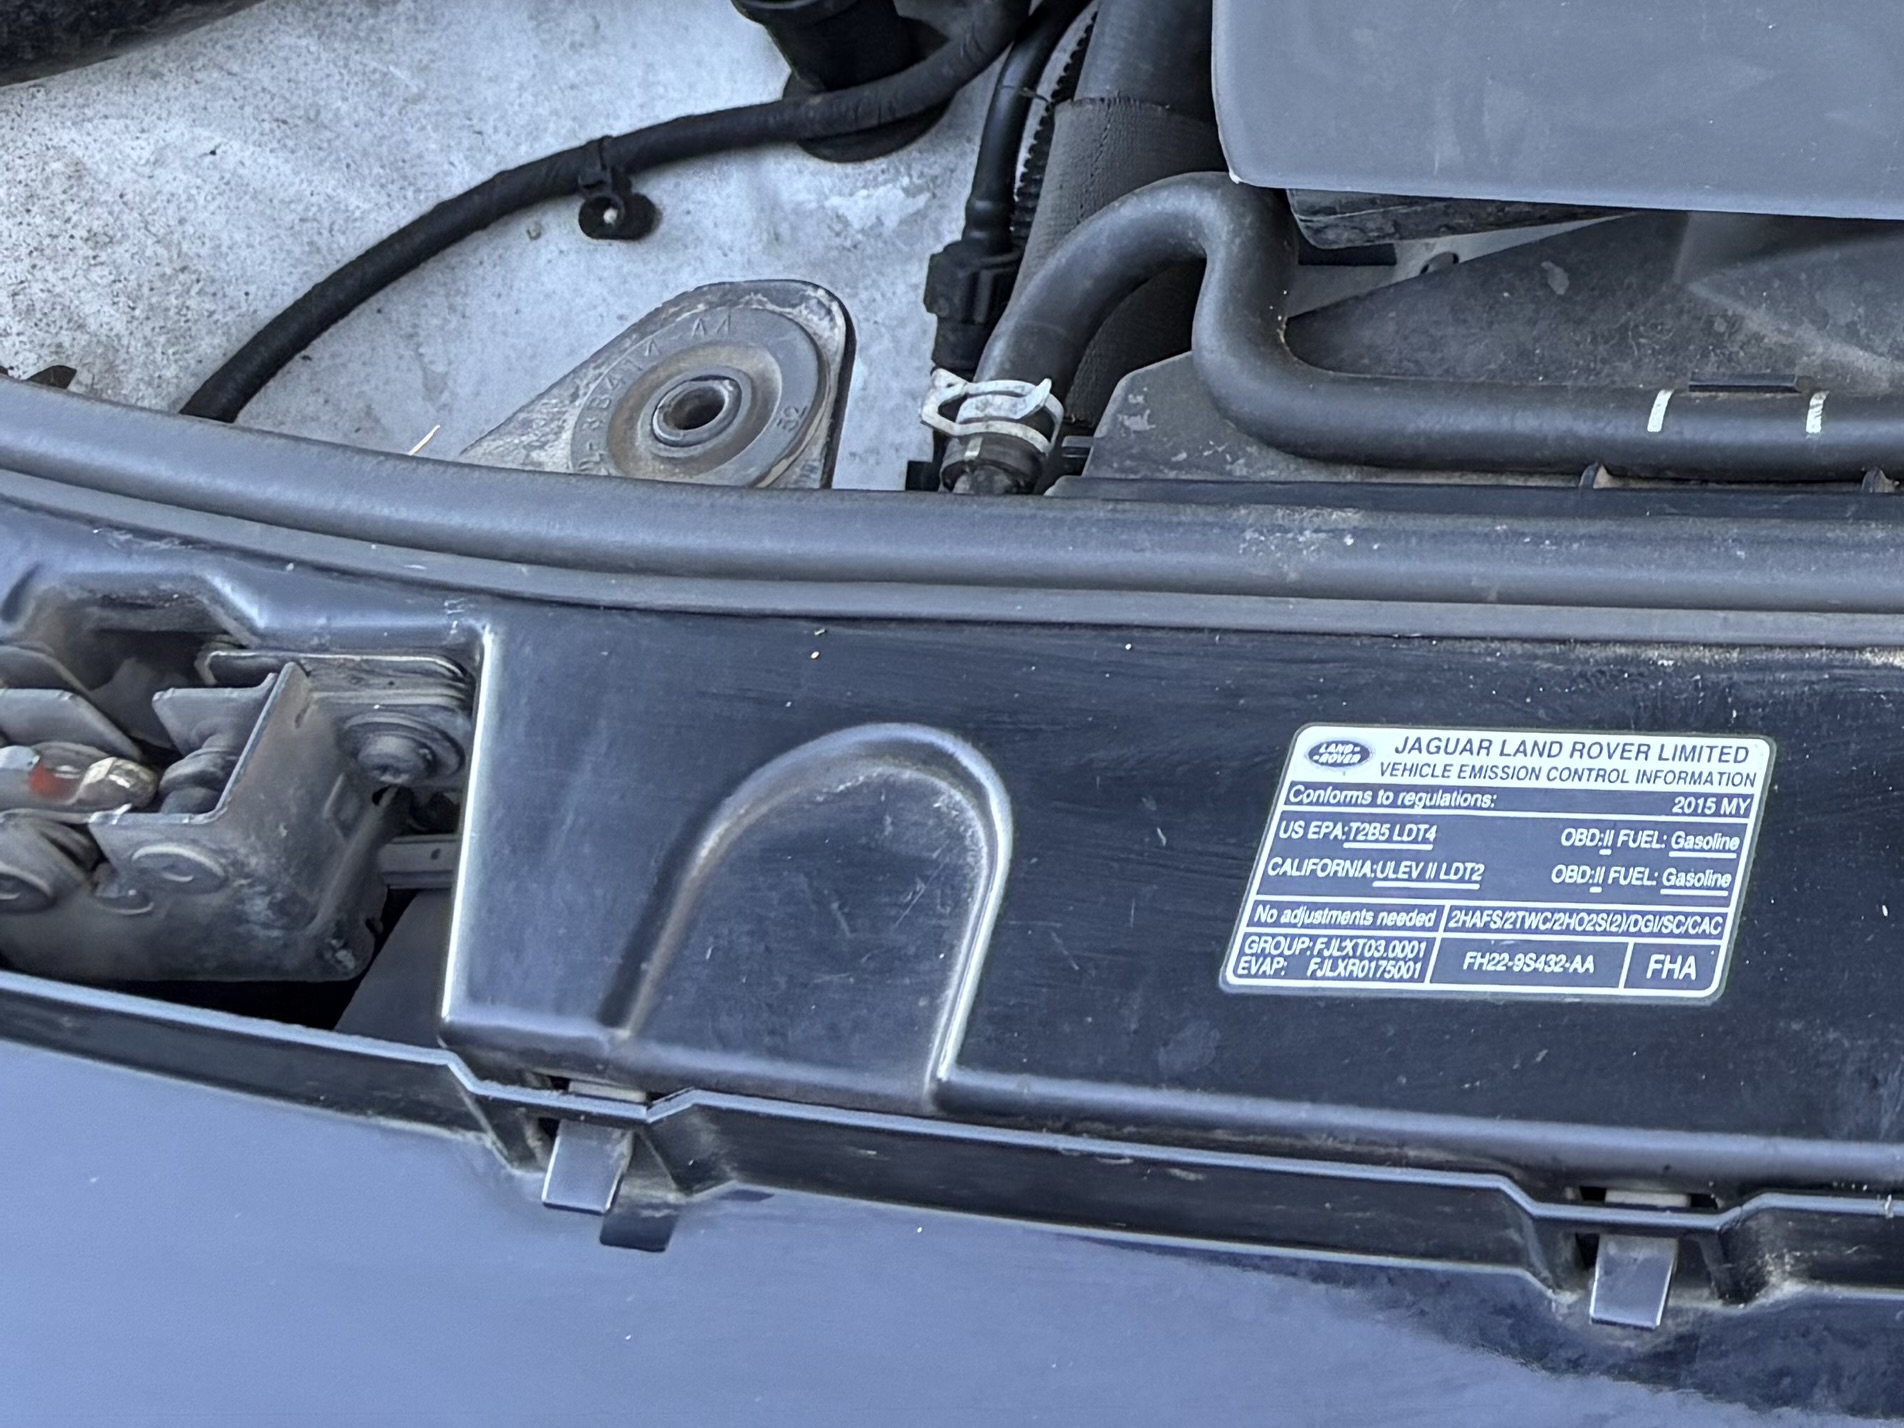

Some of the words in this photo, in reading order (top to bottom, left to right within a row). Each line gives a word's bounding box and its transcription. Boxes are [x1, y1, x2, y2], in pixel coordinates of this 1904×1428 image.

[1394, 736, 1493, 757] JAGUAR
[1499, 739, 1562, 758] LAND
[1569, 741, 1651, 762] ROVER
[1657, 743, 1750, 764] LIMITED
[1379, 761, 1454, 778] VEHICLE
[1457, 763, 1542, 781] EMISSION
[1546, 765, 1630, 784] CONTROL
[1635, 768, 1757, 788] INFORMATION
[1288, 785, 1372, 805] Conforms
[1376, 788, 1394, 805] to
[1397, 789, 1498, 810] regulations:
[1671, 796, 1717, 815] 2015
[1720, 797, 1752, 816] MY
[1278, 820, 1305, 839] US
[1392, 823, 1438, 842] LDT4
[1616, 829, 1668, 849] FUEL:
[1670, 830, 1741, 851] Gasoline
[1439, 862, 1485, 881] LDT2
[1607, 866, 1659, 886] FUEL:
[1661, 867, 1732, 889] Gasoline
[1253, 904, 1278, 923] No
[1280, 906, 1375, 927] adjustments
[1376, 909, 1437, 927] needed
[1236, 956, 1288, 976] EVAP:
[1645, 954, 1697, 981] FHA
